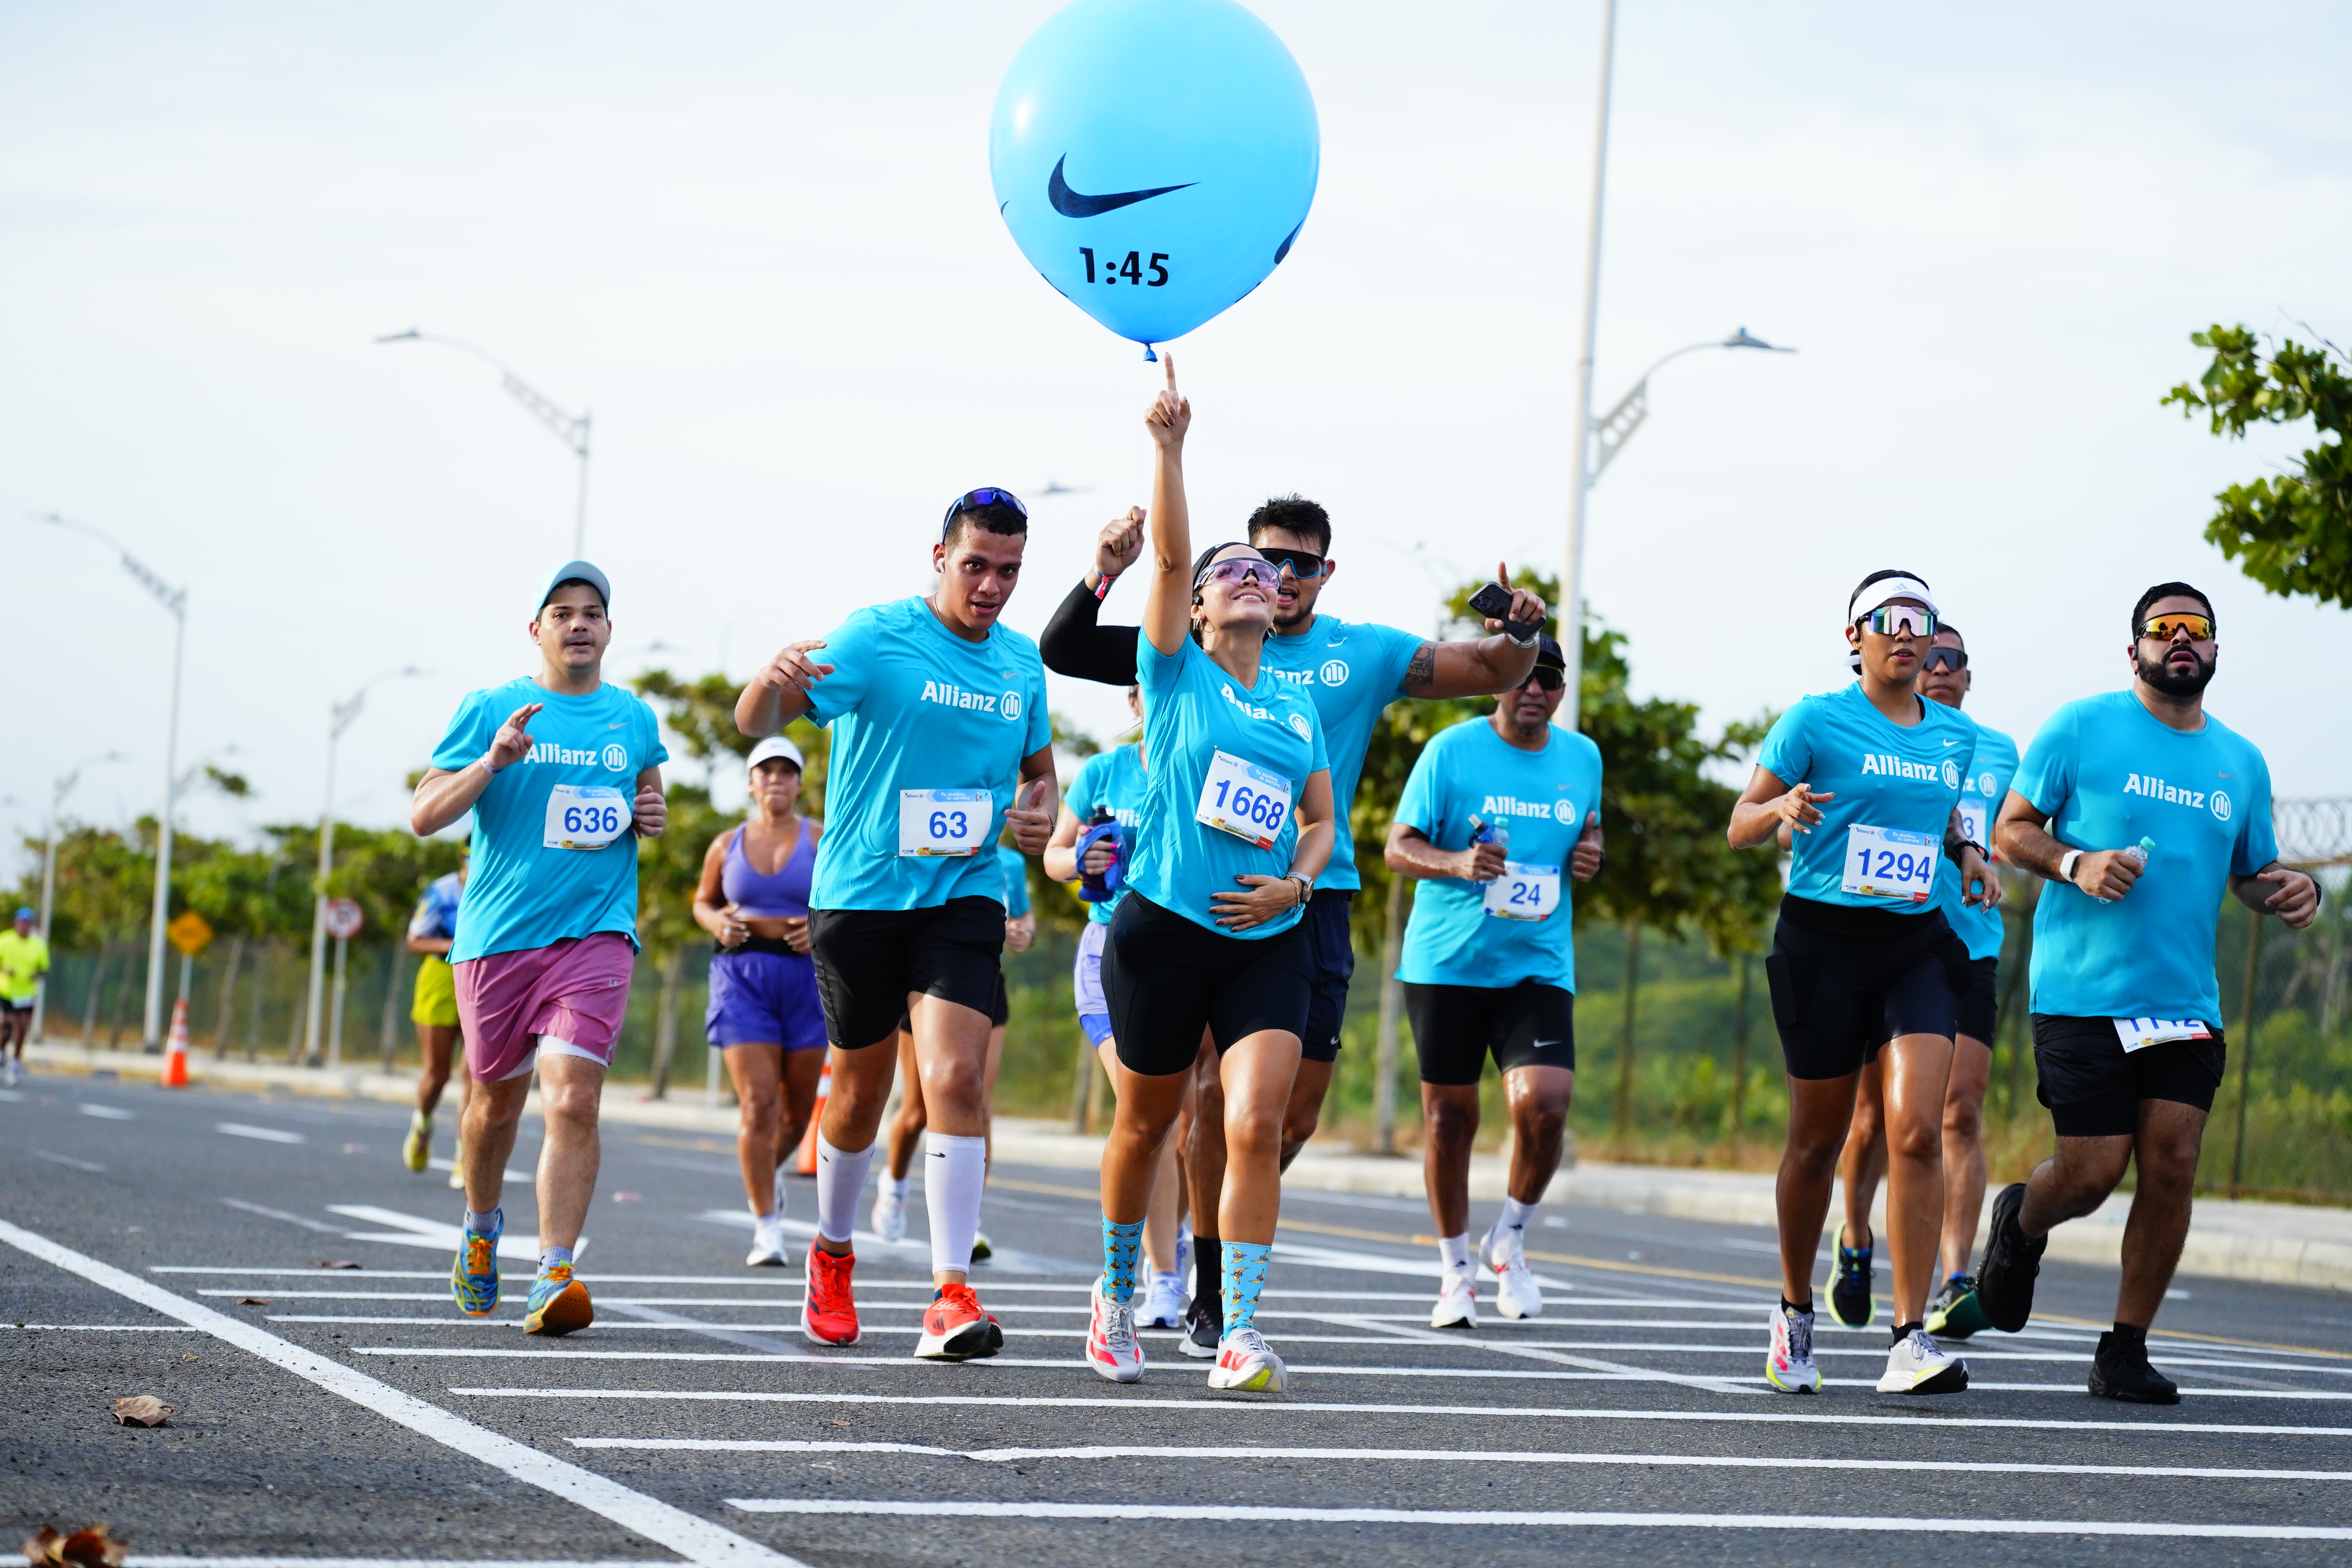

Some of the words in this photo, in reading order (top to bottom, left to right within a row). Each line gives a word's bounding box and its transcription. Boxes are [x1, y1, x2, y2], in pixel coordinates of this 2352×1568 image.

[1080, 247, 1169, 286] 1:45
[920, 681, 996, 712] Allianz
[523, 743, 597, 765] Allianz
[1861, 754, 1938, 782] Allianz
[1216, 779, 1284, 831] 1668
[2123, 773, 2204, 809] Allianz
[565, 807, 618, 833] 636
[1482, 796, 1551, 819] Allianz
[929, 811, 967, 839] 63
[1858, 848, 1930, 884] 1294
[1509, 882, 1541, 906] 24
